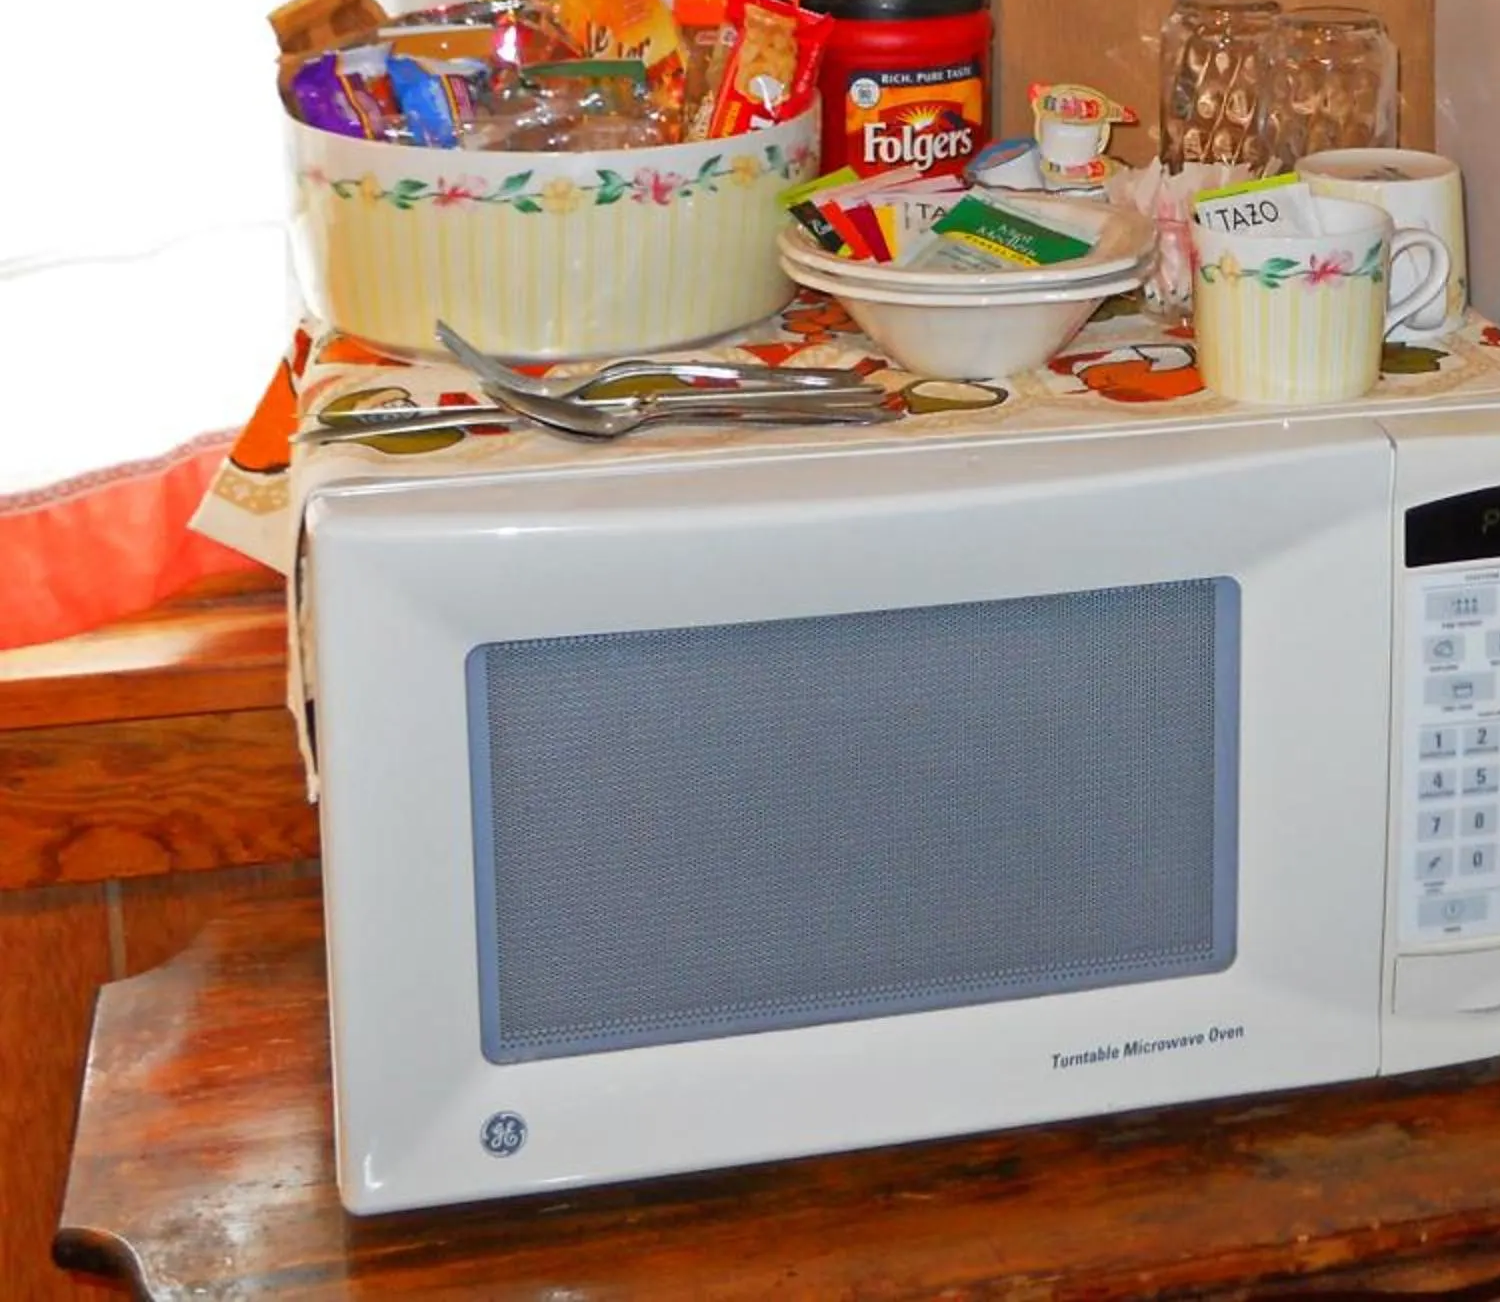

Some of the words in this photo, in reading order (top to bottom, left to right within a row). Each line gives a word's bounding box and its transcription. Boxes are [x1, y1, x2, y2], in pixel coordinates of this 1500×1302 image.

[863, 121, 973, 172] Folgers
[1215, 200, 1279, 233] TAZO
[1434, 732, 1442, 748] 1
[1476, 727, 1487, 745] 2
[1433, 771, 1442, 789] 4
[1476, 767, 1487, 785] 5
[1432, 815, 1441, 834] 7
[1472, 850, 1483, 868] 0
[1051, 1044, 1120, 1069] Turntable
[1123, 1032, 1205, 1058] Microwave
[1208, 1025, 1245, 1043] Oven
